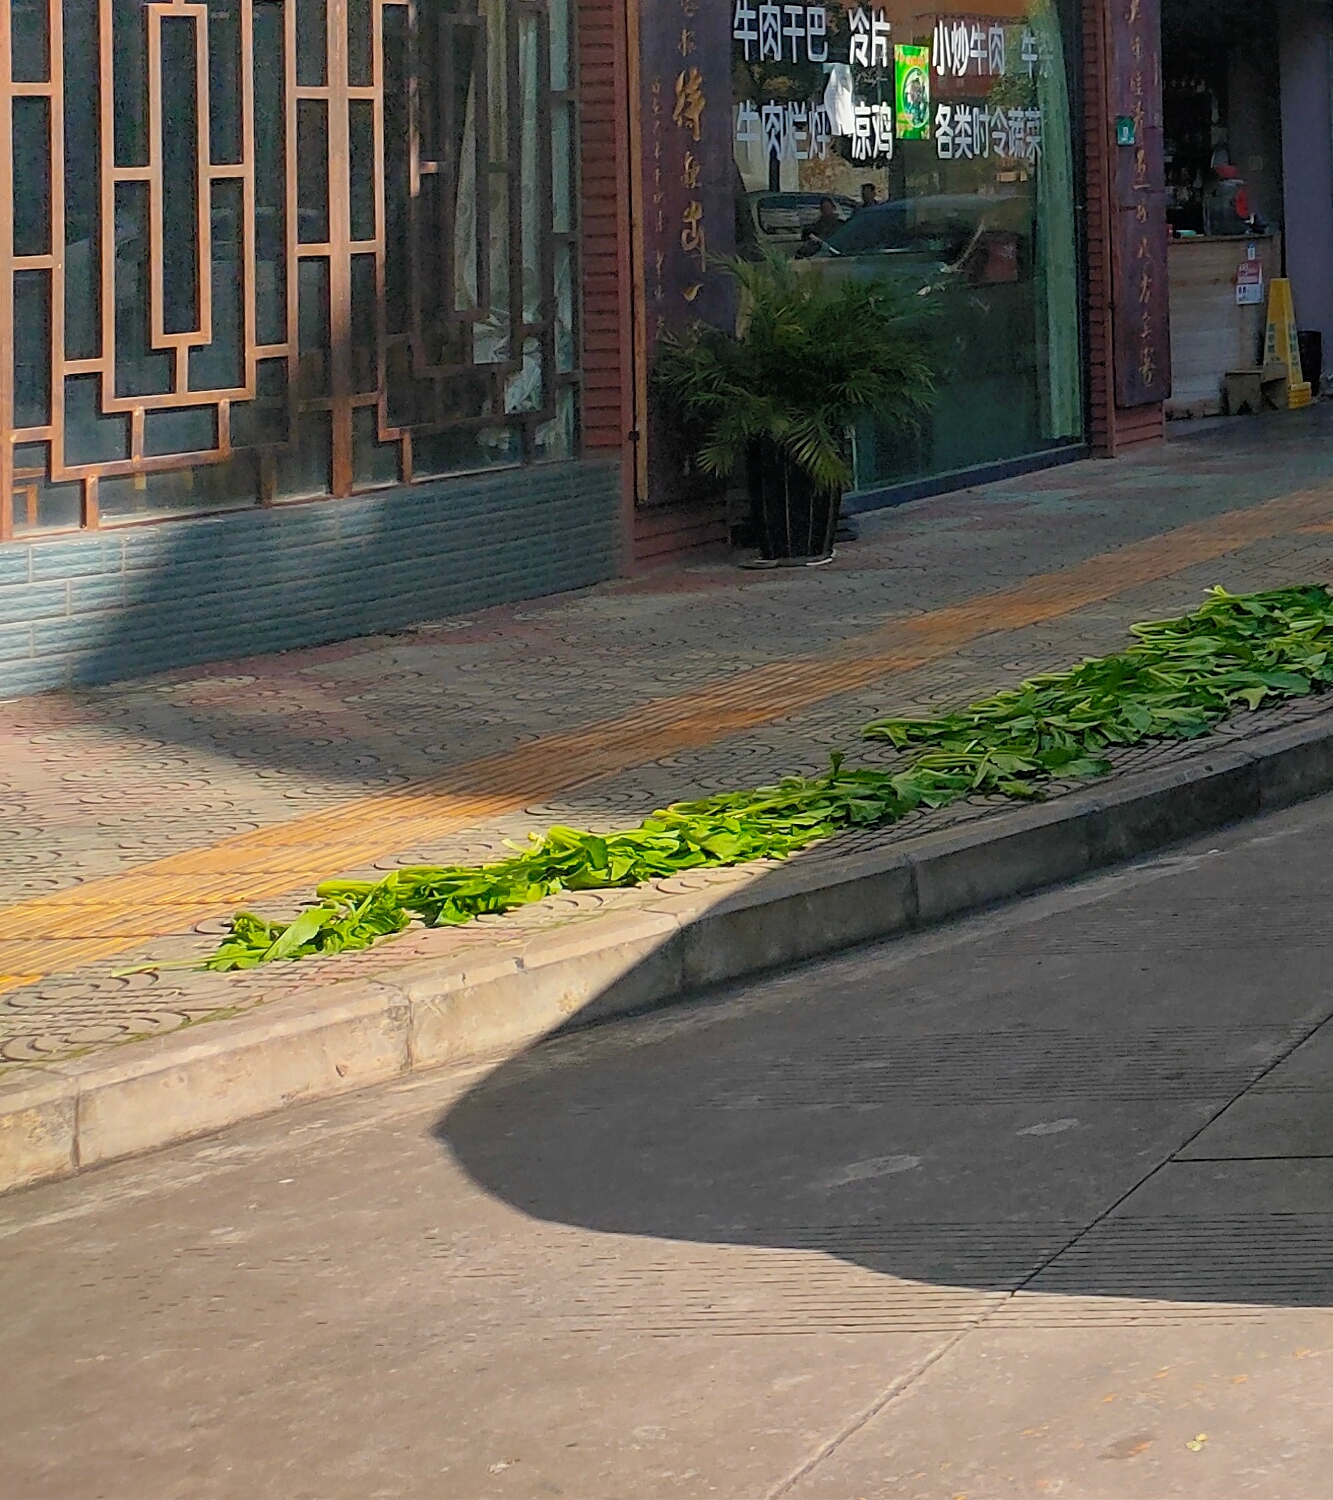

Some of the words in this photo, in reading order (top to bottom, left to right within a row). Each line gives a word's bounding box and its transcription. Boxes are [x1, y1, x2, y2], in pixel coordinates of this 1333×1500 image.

[849, 9, 891, 68] 冷片
[932, 19, 1004, 77] 小炒牛肉
[935, 103, 1043, 168] 各类时令蔬菜
